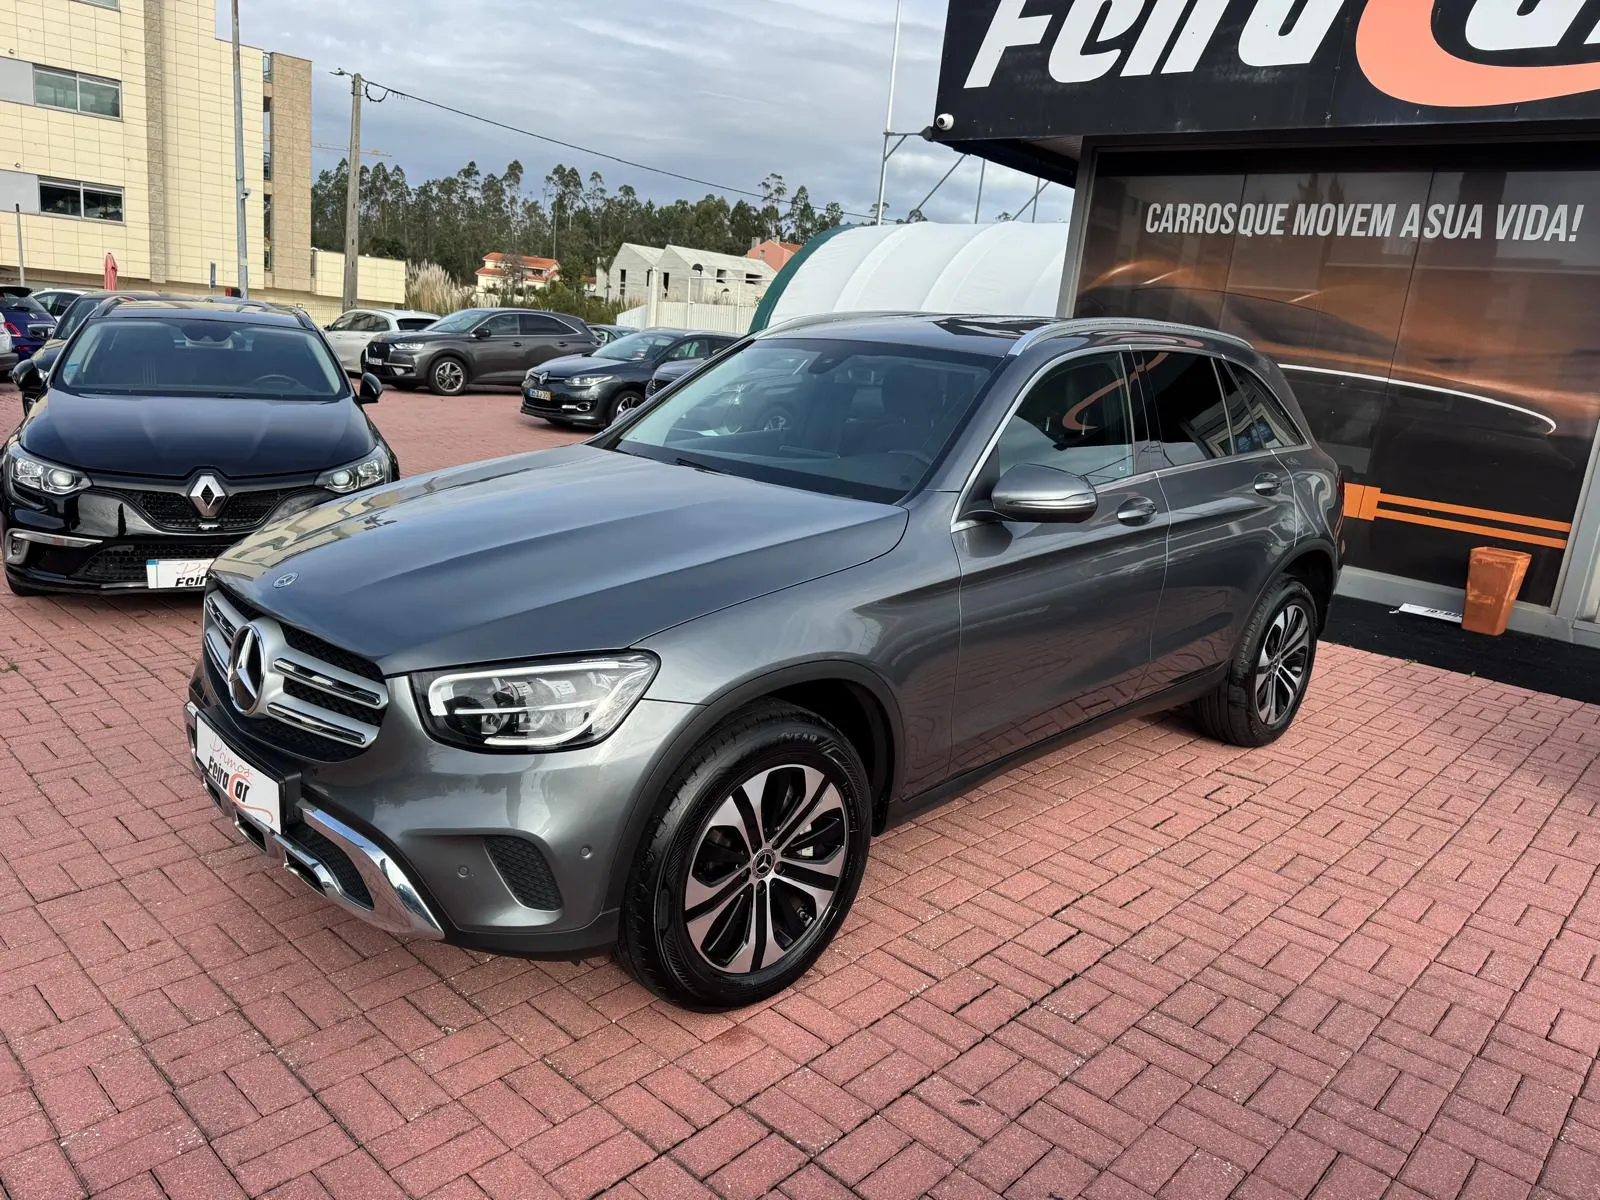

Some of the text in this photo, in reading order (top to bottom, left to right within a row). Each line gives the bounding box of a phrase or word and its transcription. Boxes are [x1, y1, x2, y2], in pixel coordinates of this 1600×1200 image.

[1145, 202, 1585, 243] CARROS QUE MOVEM A SUA VIDA!
[175, 574, 207, 587] Feir
